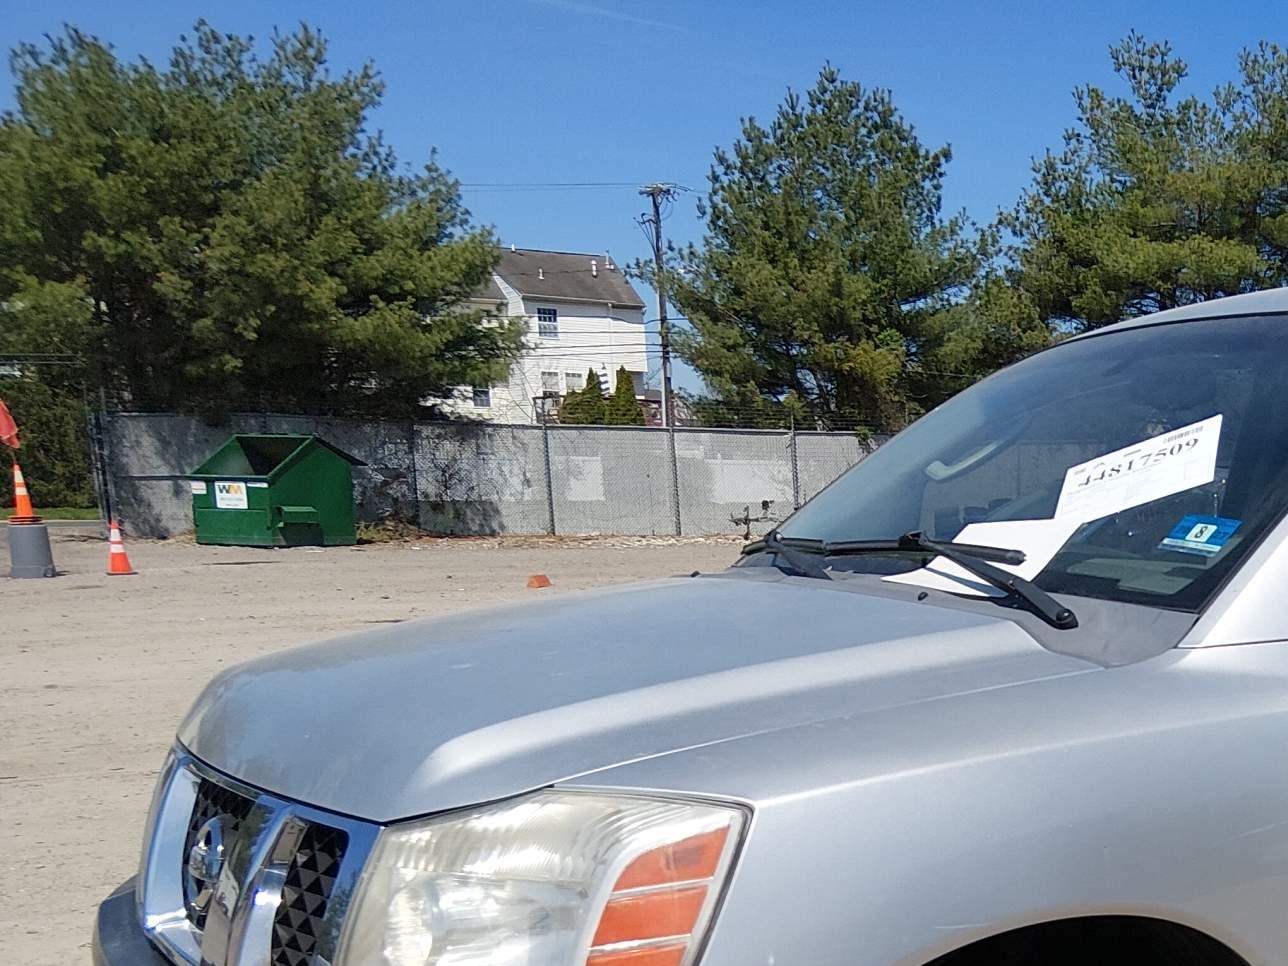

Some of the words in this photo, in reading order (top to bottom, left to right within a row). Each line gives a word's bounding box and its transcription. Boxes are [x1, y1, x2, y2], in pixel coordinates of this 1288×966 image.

[1077, 437, 1200, 488] 44817509
[217, 484, 243, 495] WM
[1194, 525, 1209, 539] 8
